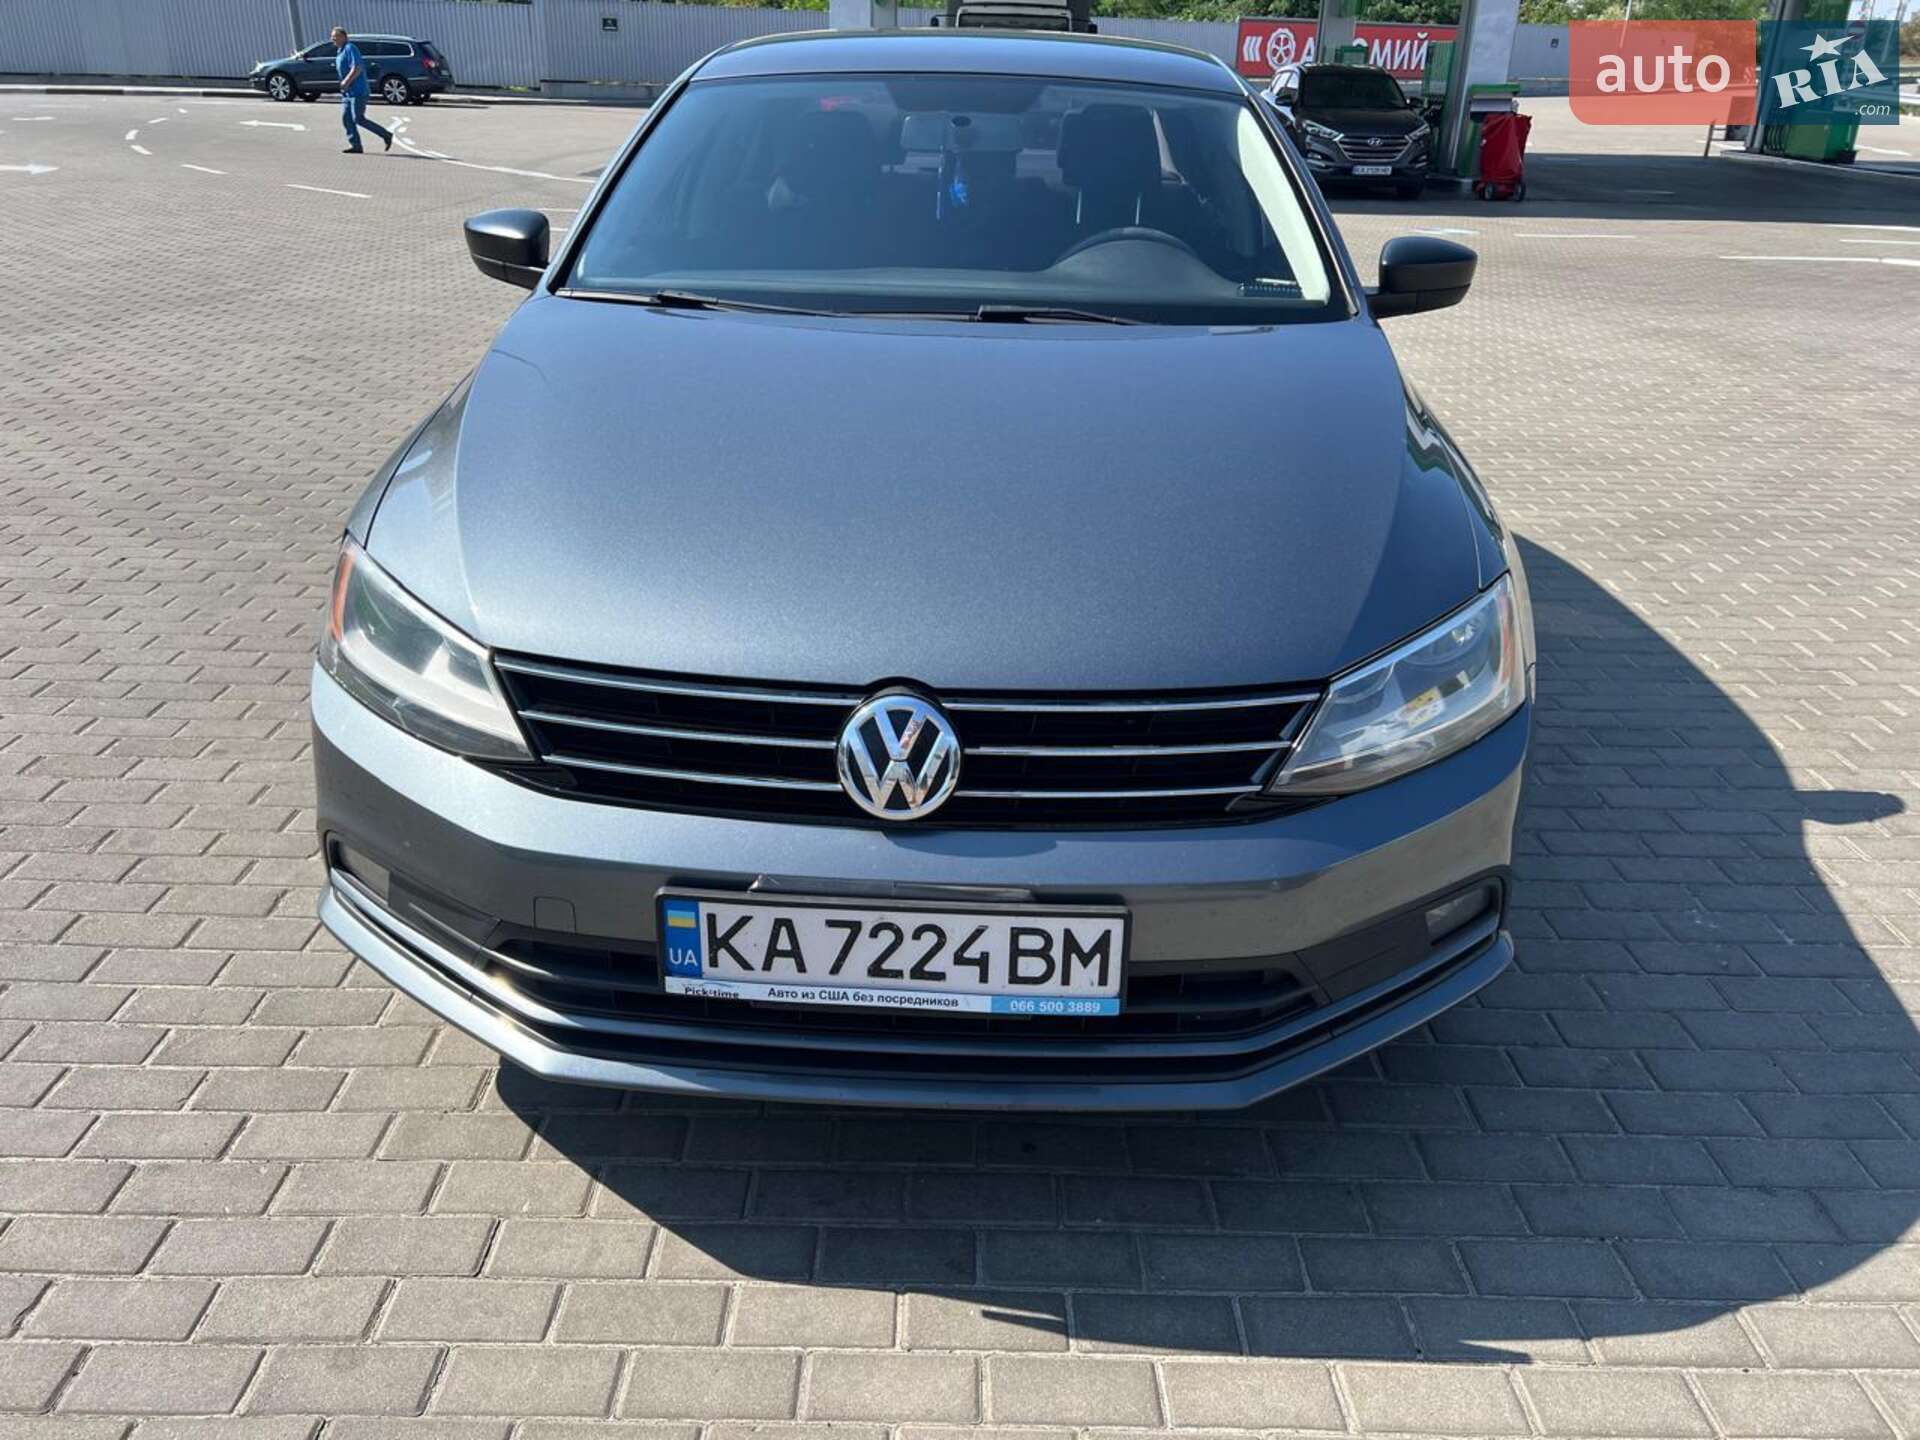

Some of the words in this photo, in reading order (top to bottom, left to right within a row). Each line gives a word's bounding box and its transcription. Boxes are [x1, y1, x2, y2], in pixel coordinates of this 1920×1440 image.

[669, 948, 698, 967] UA
[706, 912, 807, 974] KA
[825, 919, 989, 984] 7224
[1008, 927, 1112, 987] BM
[767, 987, 799, 999] Авто
[801, 989, 816, 1000] из
[818, 989, 849, 1001] США
[852, 991, 874, 1003] без
[876, 992, 959, 1008] посредников
[1010, 1000, 1035, 1012] 066
[1040, 1001, 1064, 1012] 500
[1067, 1001, 1101, 1013] 3889
